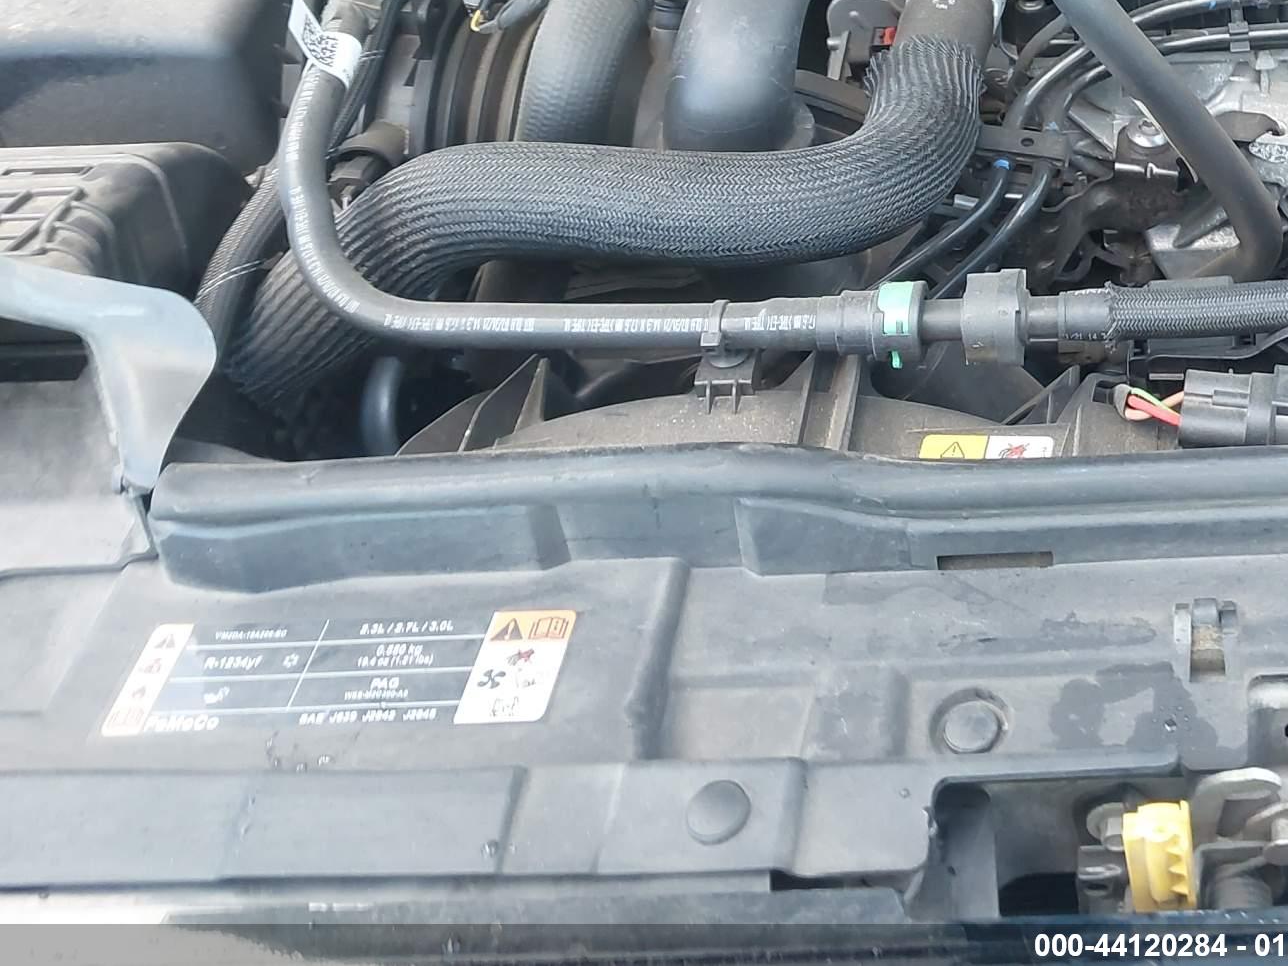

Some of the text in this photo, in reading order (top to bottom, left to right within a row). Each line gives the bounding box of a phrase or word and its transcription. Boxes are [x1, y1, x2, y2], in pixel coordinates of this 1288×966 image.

[429, 620, 454, 633] 3.0L
[408, 643, 423, 656] kg
[203, 655, 263, 671] R-1234yf
[370, 677, 400, 690] PAG
[144, 714, 220, 732] FoMoCo
